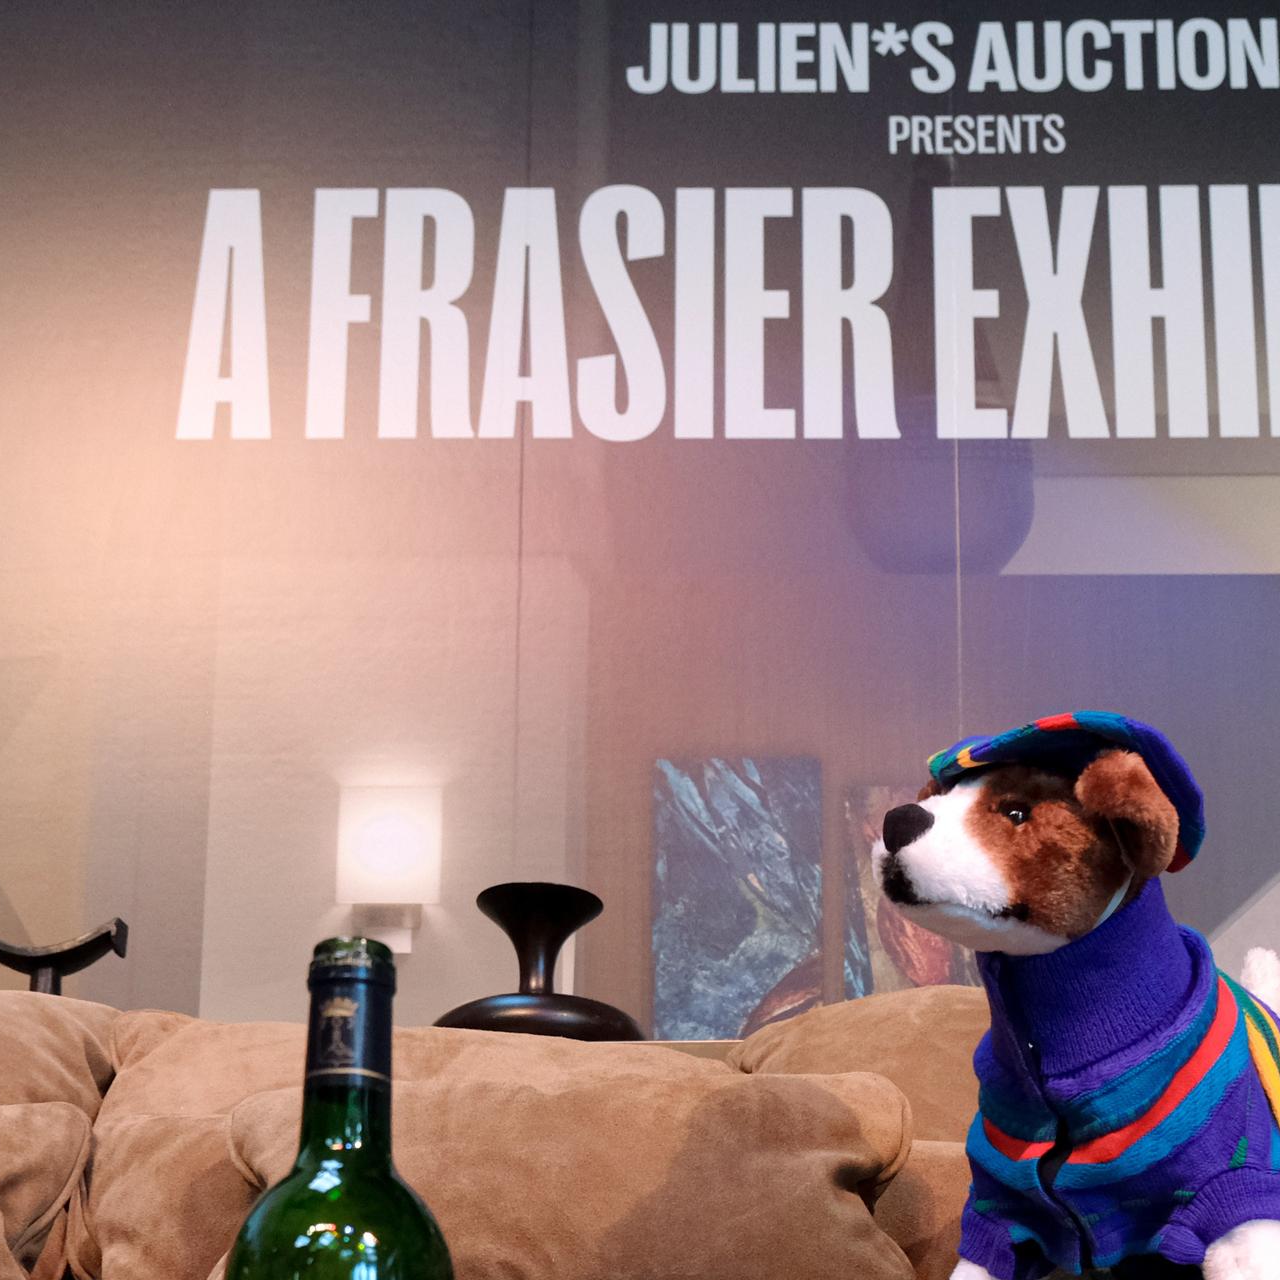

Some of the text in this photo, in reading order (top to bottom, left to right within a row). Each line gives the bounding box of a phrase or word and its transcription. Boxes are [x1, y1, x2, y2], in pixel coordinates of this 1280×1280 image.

[888, 114, 1066, 154] PRESENTS
[175, 188, 271, 440] A
[305, 184, 901, 442] FRASIER
